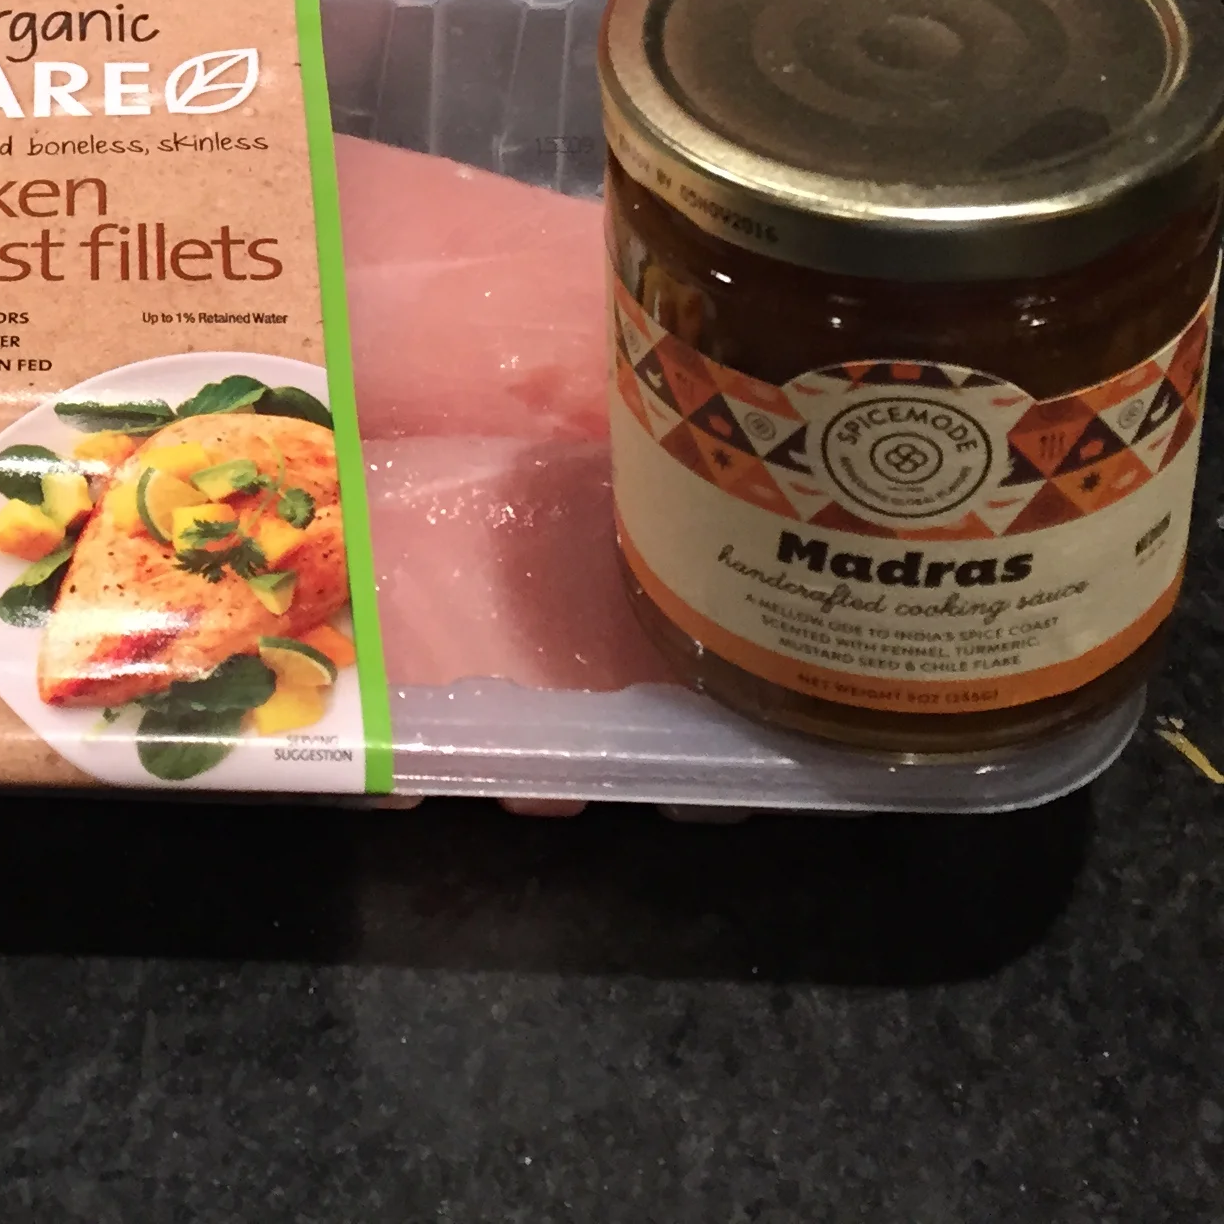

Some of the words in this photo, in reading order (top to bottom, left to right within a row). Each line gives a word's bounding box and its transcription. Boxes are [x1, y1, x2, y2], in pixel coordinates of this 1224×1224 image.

[26, 135, 151, 156] boneless,
[156, 131, 270, 154] skinless
[79, 222, 284, 282] fillets
[142, 311, 158, 325] Up
[161, 312, 173, 324] to
[176, 312, 195, 324] 1%
[198, 312, 250, 324] Retained
[252, 312, 288, 324] Water
[17, 358, 53, 372] FED
[836, 406, 978, 454] SPICEMODE
[777, 530, 1034, 588] Madras
[717, 544, 887, 615] handcrafted
[894, 592, 1012, 626] cooking
[1015, 580, 1089, 611] sauce
[274, 748, 353, 762] SUGGESTION
